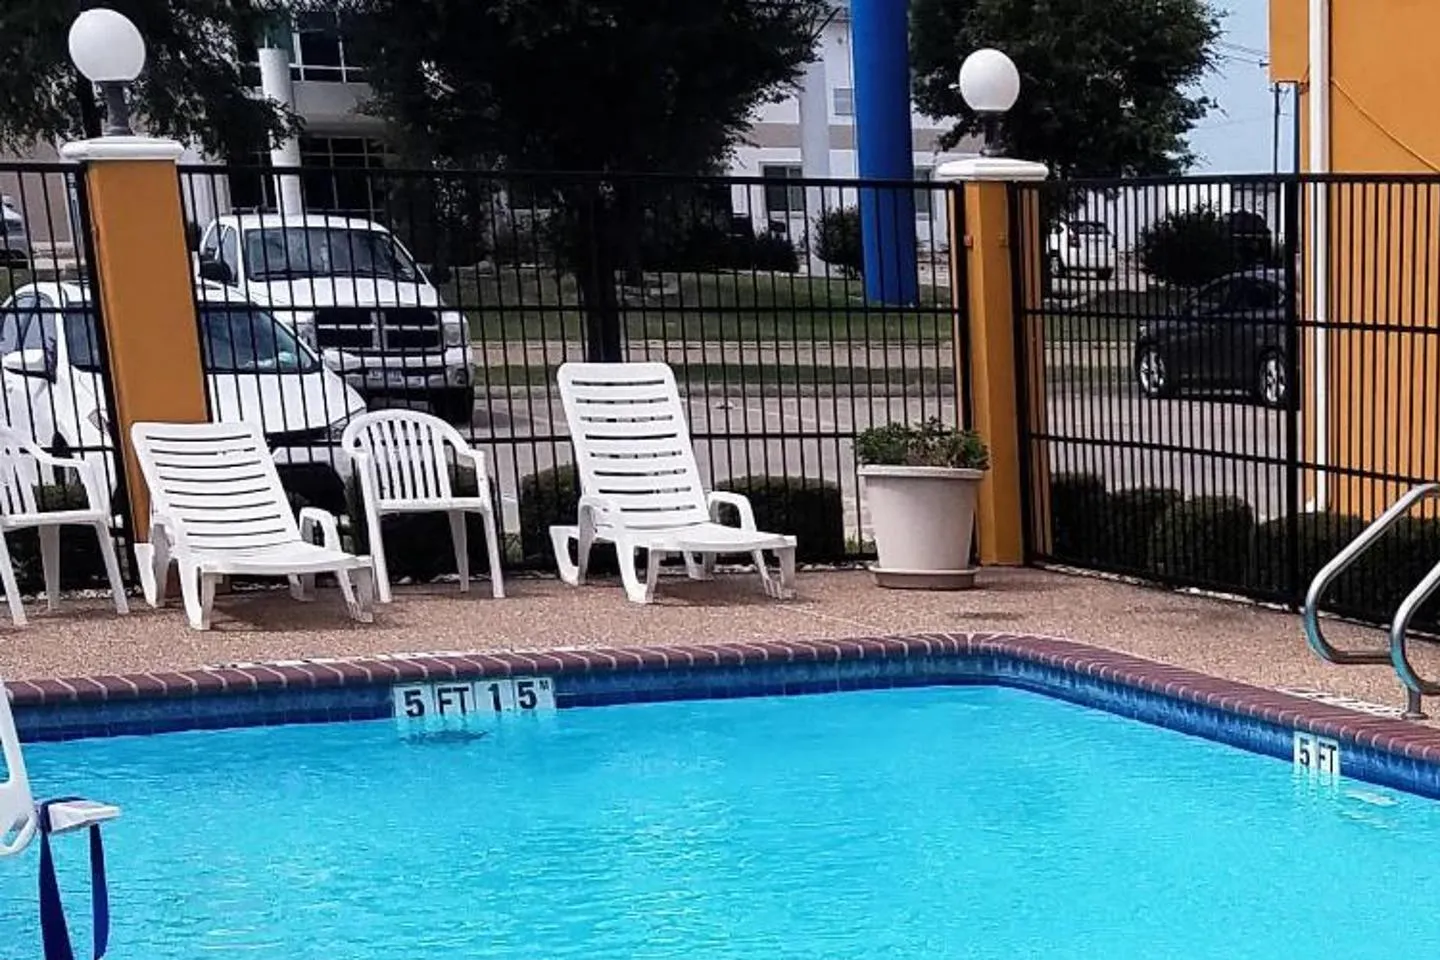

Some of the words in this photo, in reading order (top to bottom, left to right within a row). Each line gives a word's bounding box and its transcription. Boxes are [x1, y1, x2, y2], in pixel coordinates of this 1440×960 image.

[403, 689, 425, 717] 5
[437, 686, 470, 715] FT
[1299, 737, 1310, 767] 5
[1318, 742, 1337, 773] FT
